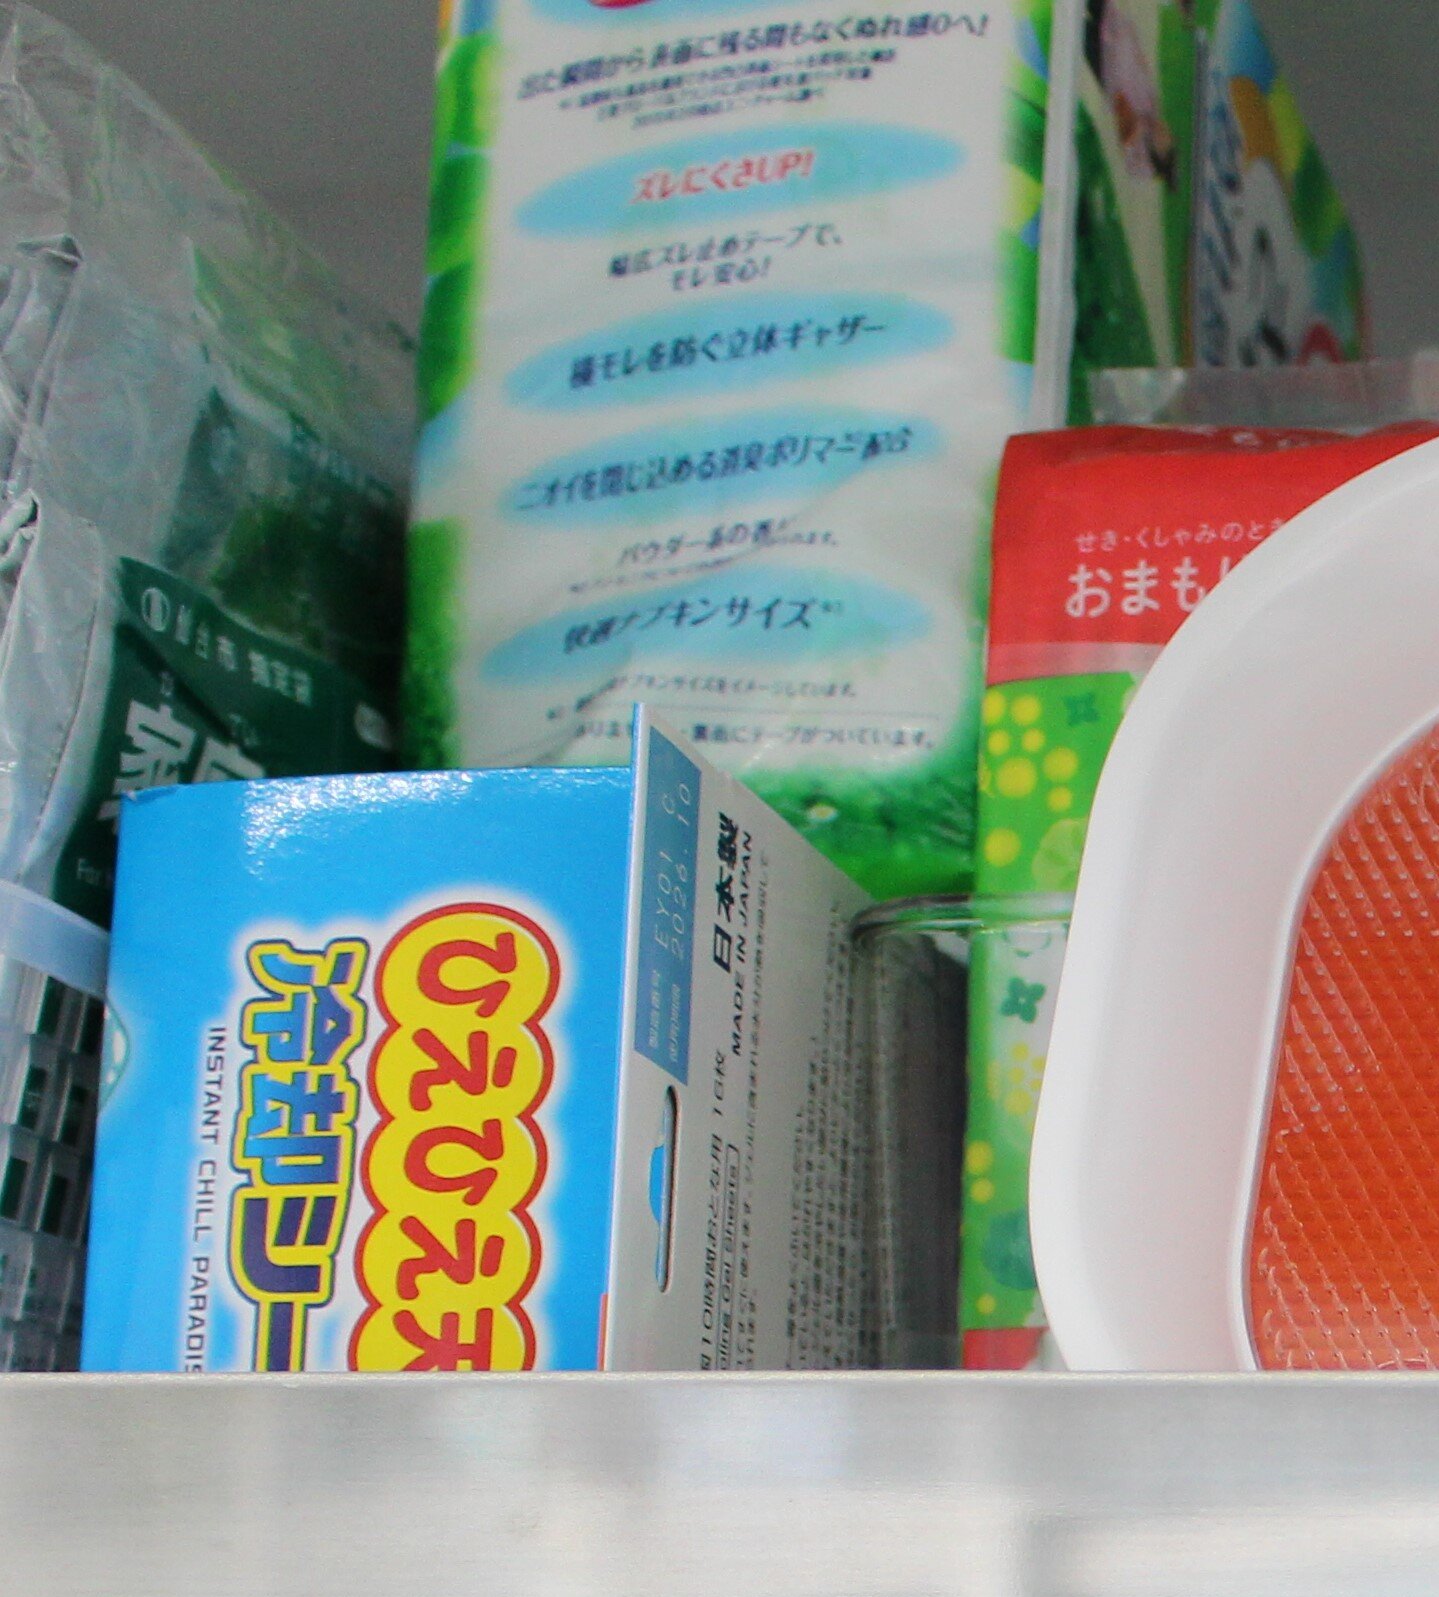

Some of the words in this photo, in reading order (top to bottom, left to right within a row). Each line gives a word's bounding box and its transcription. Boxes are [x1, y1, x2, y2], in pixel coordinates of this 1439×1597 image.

[629, 149, 816, 204] ズレにくさUP!
[568, 316, 888, 391] 横モレを防ぐ立体ギャザー
[712, 810, 741, 975] 日本製
[740, 830, 753, 927] JAPAN
[735, 934, 748, 963] IN
[731, 970, 747, 1058] MADE
[198, 1026, 226, 1146] INSTANT
[230, 939, 369, 1372] 冷却シー
[392, 931, 518, 1371] ひえひえ天
[191, 1159, 217, 1243] CHILL
